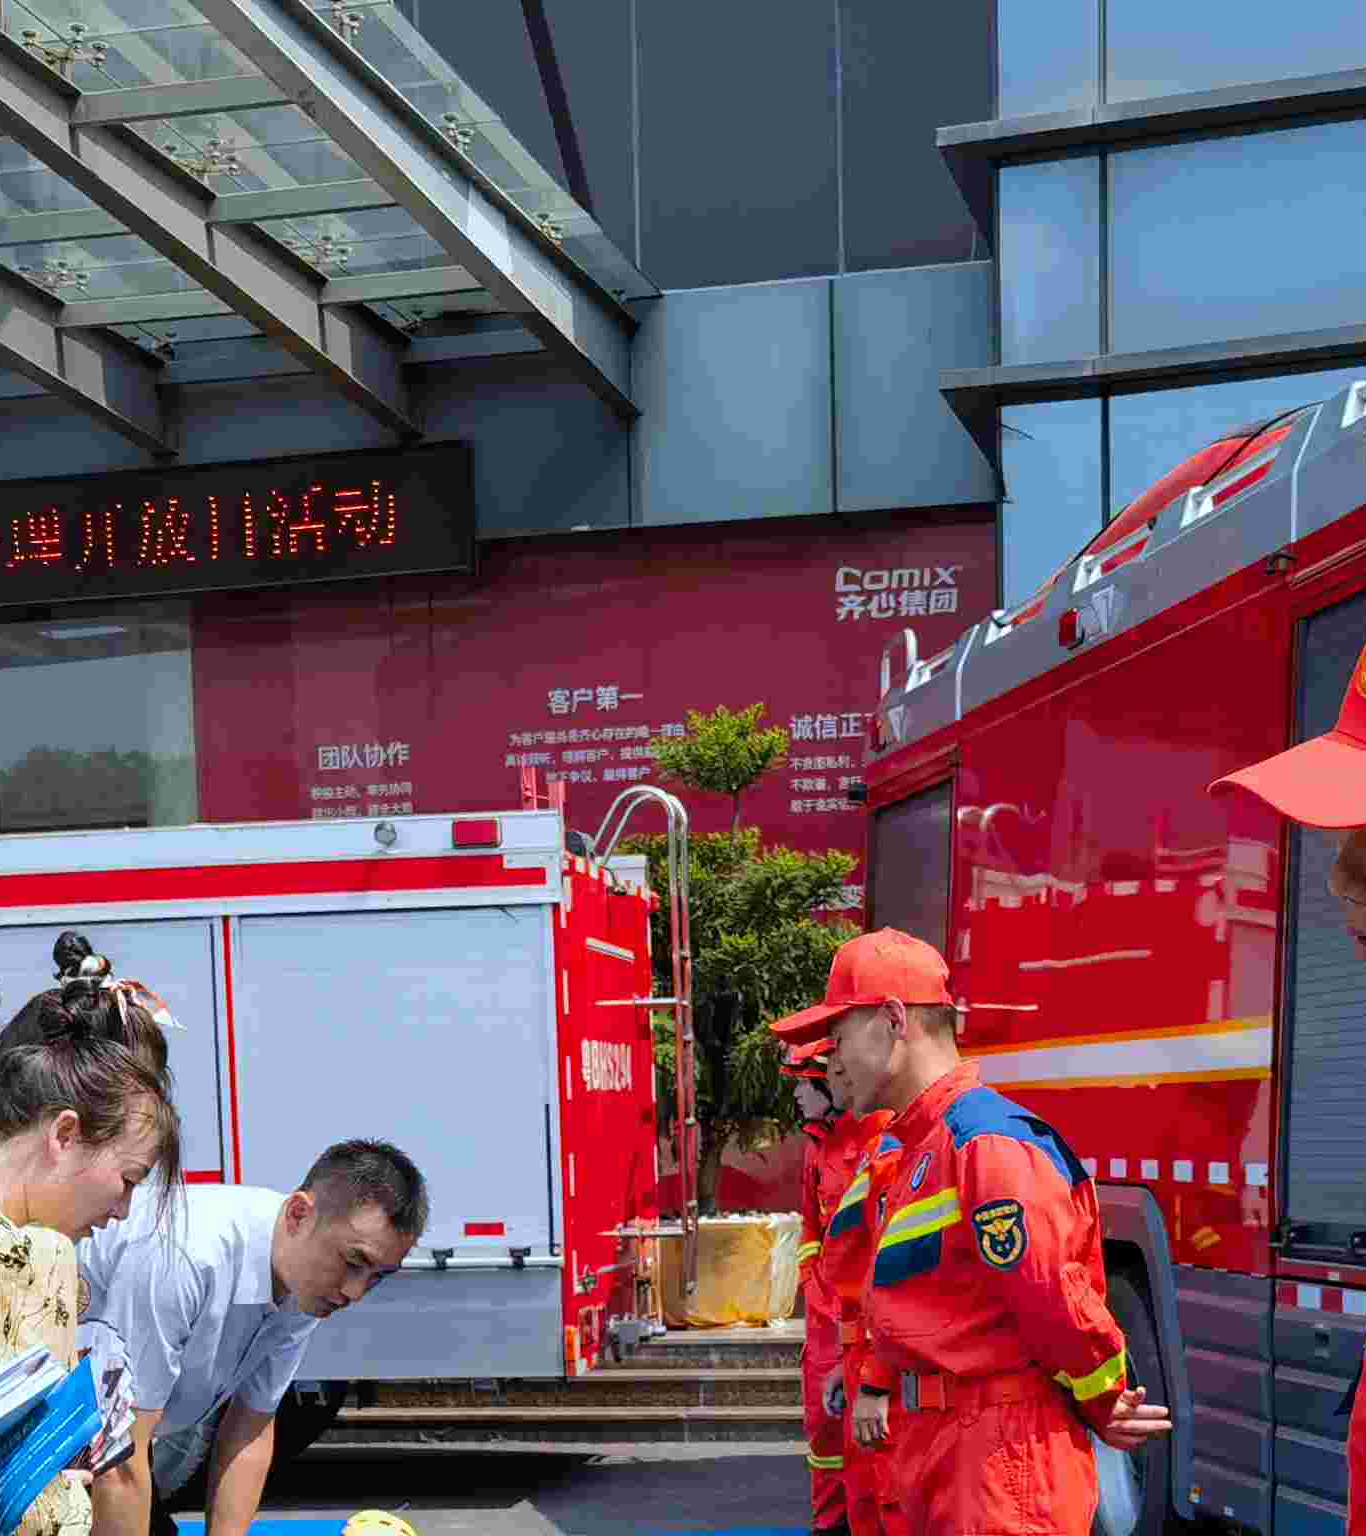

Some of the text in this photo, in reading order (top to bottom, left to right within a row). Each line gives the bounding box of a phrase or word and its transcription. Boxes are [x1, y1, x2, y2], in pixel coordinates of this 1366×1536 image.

[835, 589, 958, 622] 齐心集团
[547, 683, 644, 715] 客户第一
[318, 741, 411, 770] 团队协作
